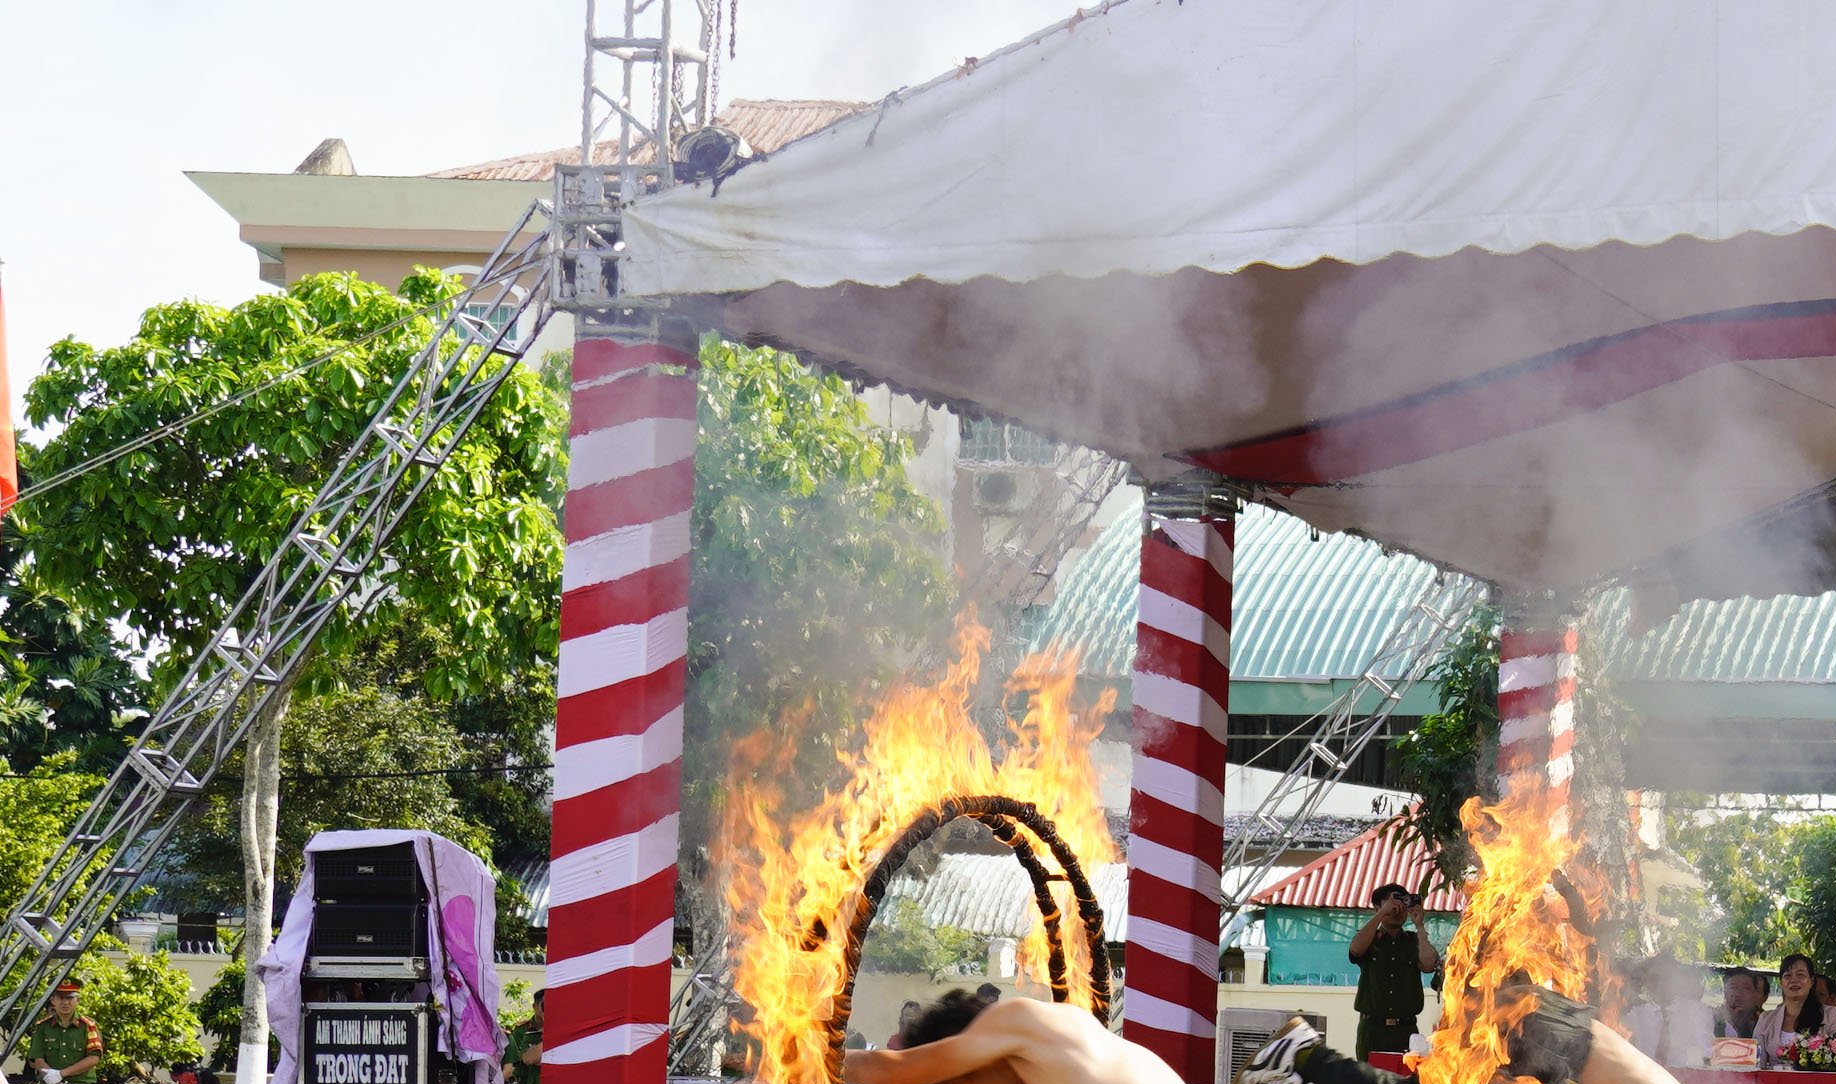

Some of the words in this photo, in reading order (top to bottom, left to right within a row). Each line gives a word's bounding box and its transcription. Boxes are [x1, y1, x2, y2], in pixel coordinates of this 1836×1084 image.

[332, 1020, 360, 1045] THANH
[362, 1015, 381, 1045] ÁNH
[383, 1015, 407, 1045] SÁNG
